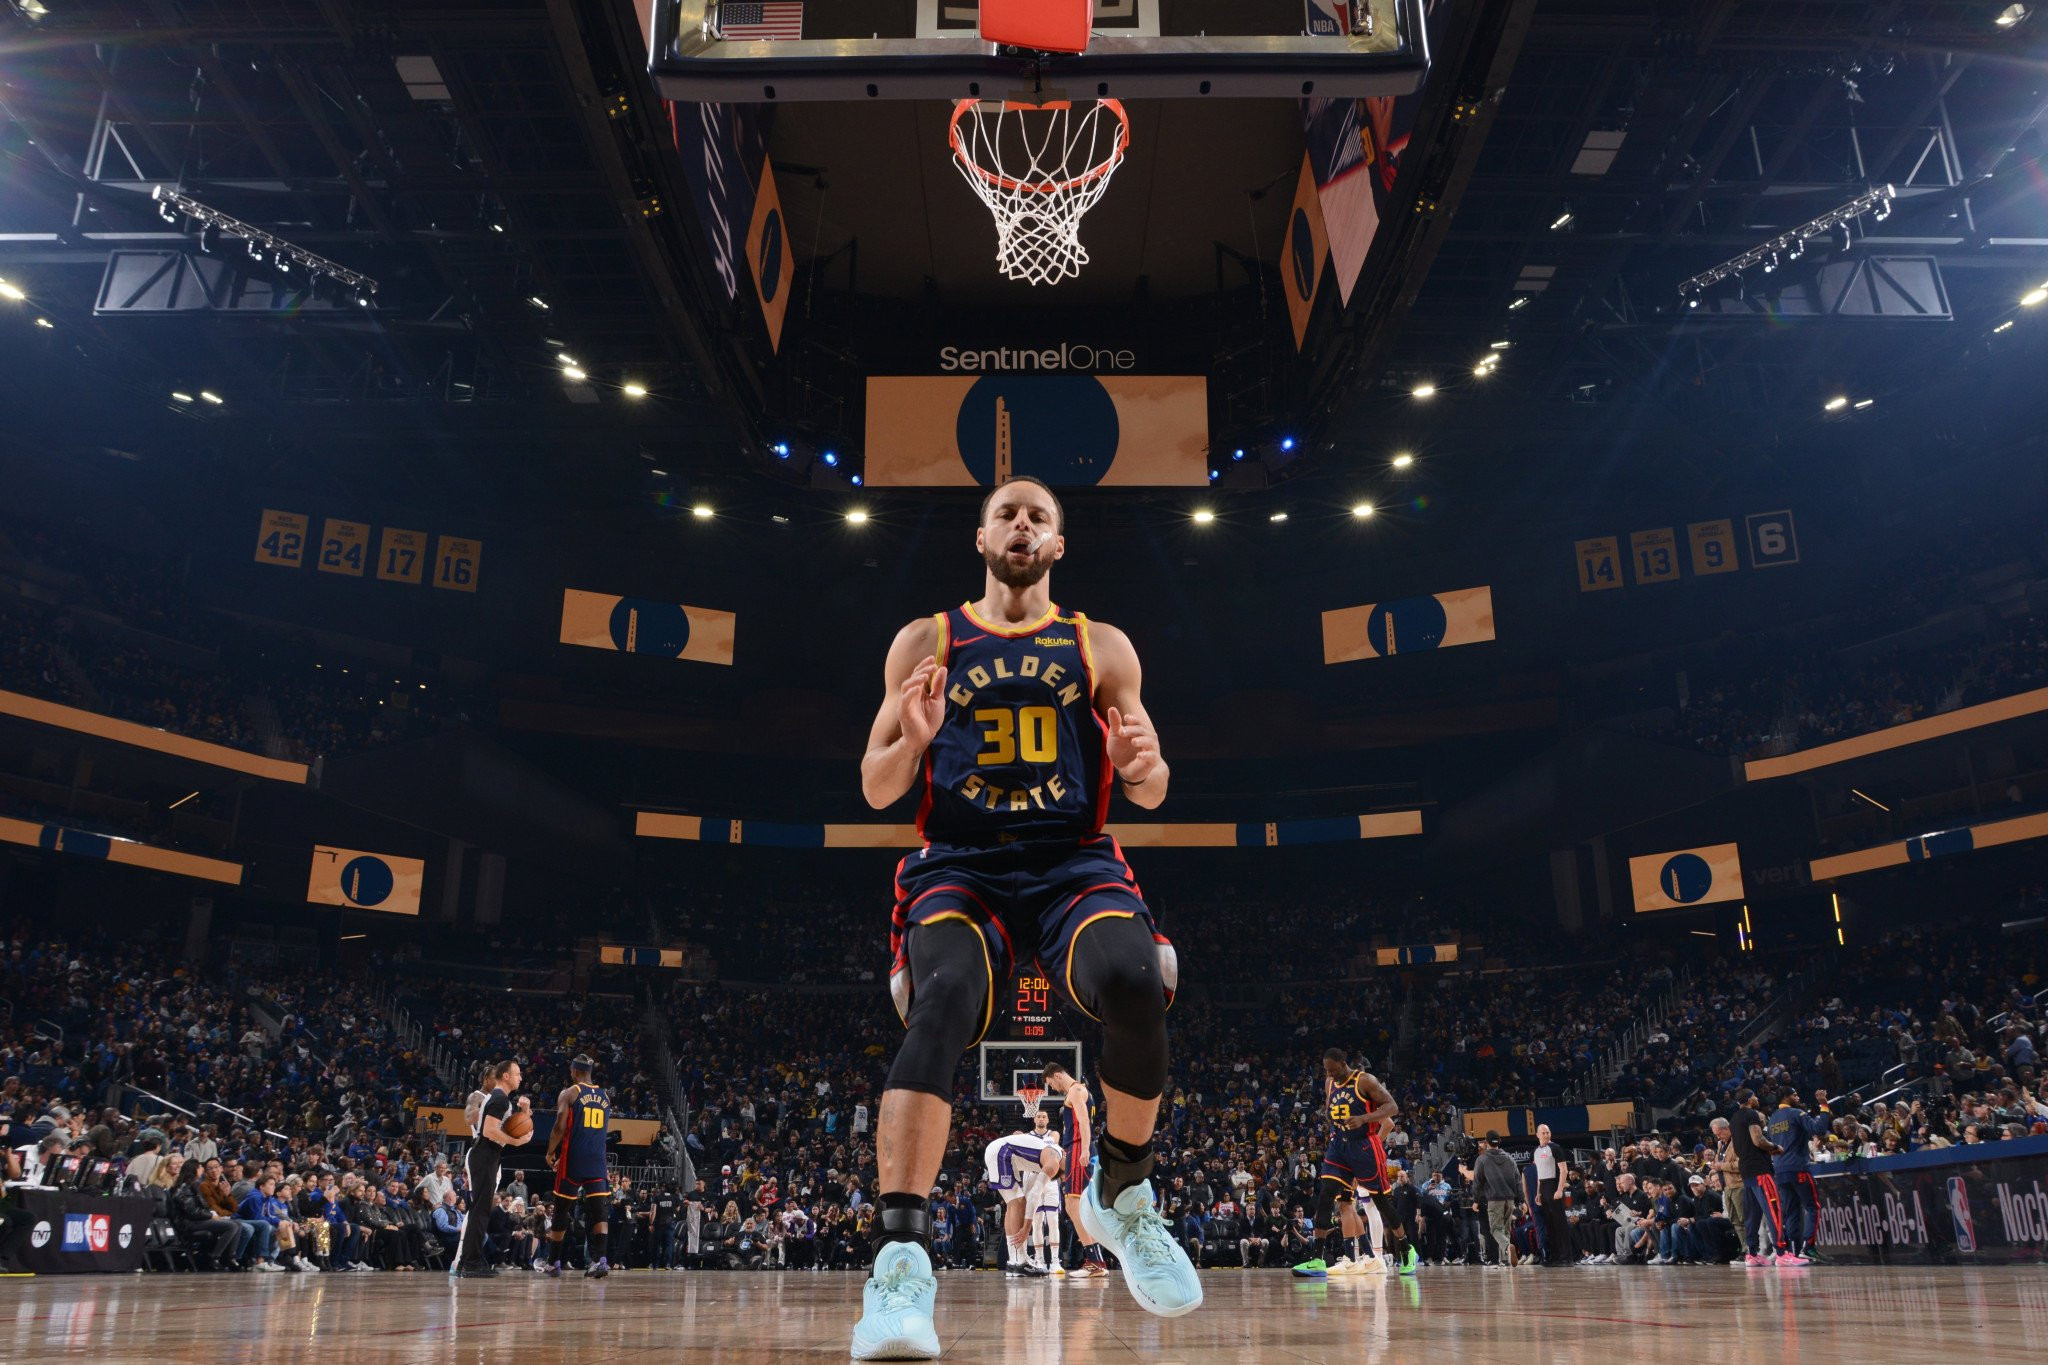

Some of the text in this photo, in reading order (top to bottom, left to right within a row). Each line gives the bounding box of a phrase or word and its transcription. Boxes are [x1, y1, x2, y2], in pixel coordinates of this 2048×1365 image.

[1313, 20, 1334, 32] NBA
[940, 342, 1135, 371] SentinelOne
[261, 530, 302, 562] 42
[1757, 522, 1787, 556] 6
[323, 538, 363, 570] 24
[386, 548, 417, 577] 17
[1639, 547, 1672, 577] 13
[1704, 540, 1724, 568] 9
[442, 555, 473, 585] 16
[1584, 555, 1616, 585] 14
[1035, 637, 1075, 647] Rakuten
[949, 655, 1082, 707] GOLDEN
[975, 706, 1057, 765] 30
[961, 773, 1067, 811] STATE
[1019, 978, 1050, 990] 12:00
[1017, 990, 1047, 1011] 24
[580, 1094, 602, 1105] BUTLER
[1331, 1104, 1350, 1119] 23
[583, 1107, 604, 1128] 10
[65, 1221, 84, 1244] NBA
[1816, 1198, 1856, 1246] oches
